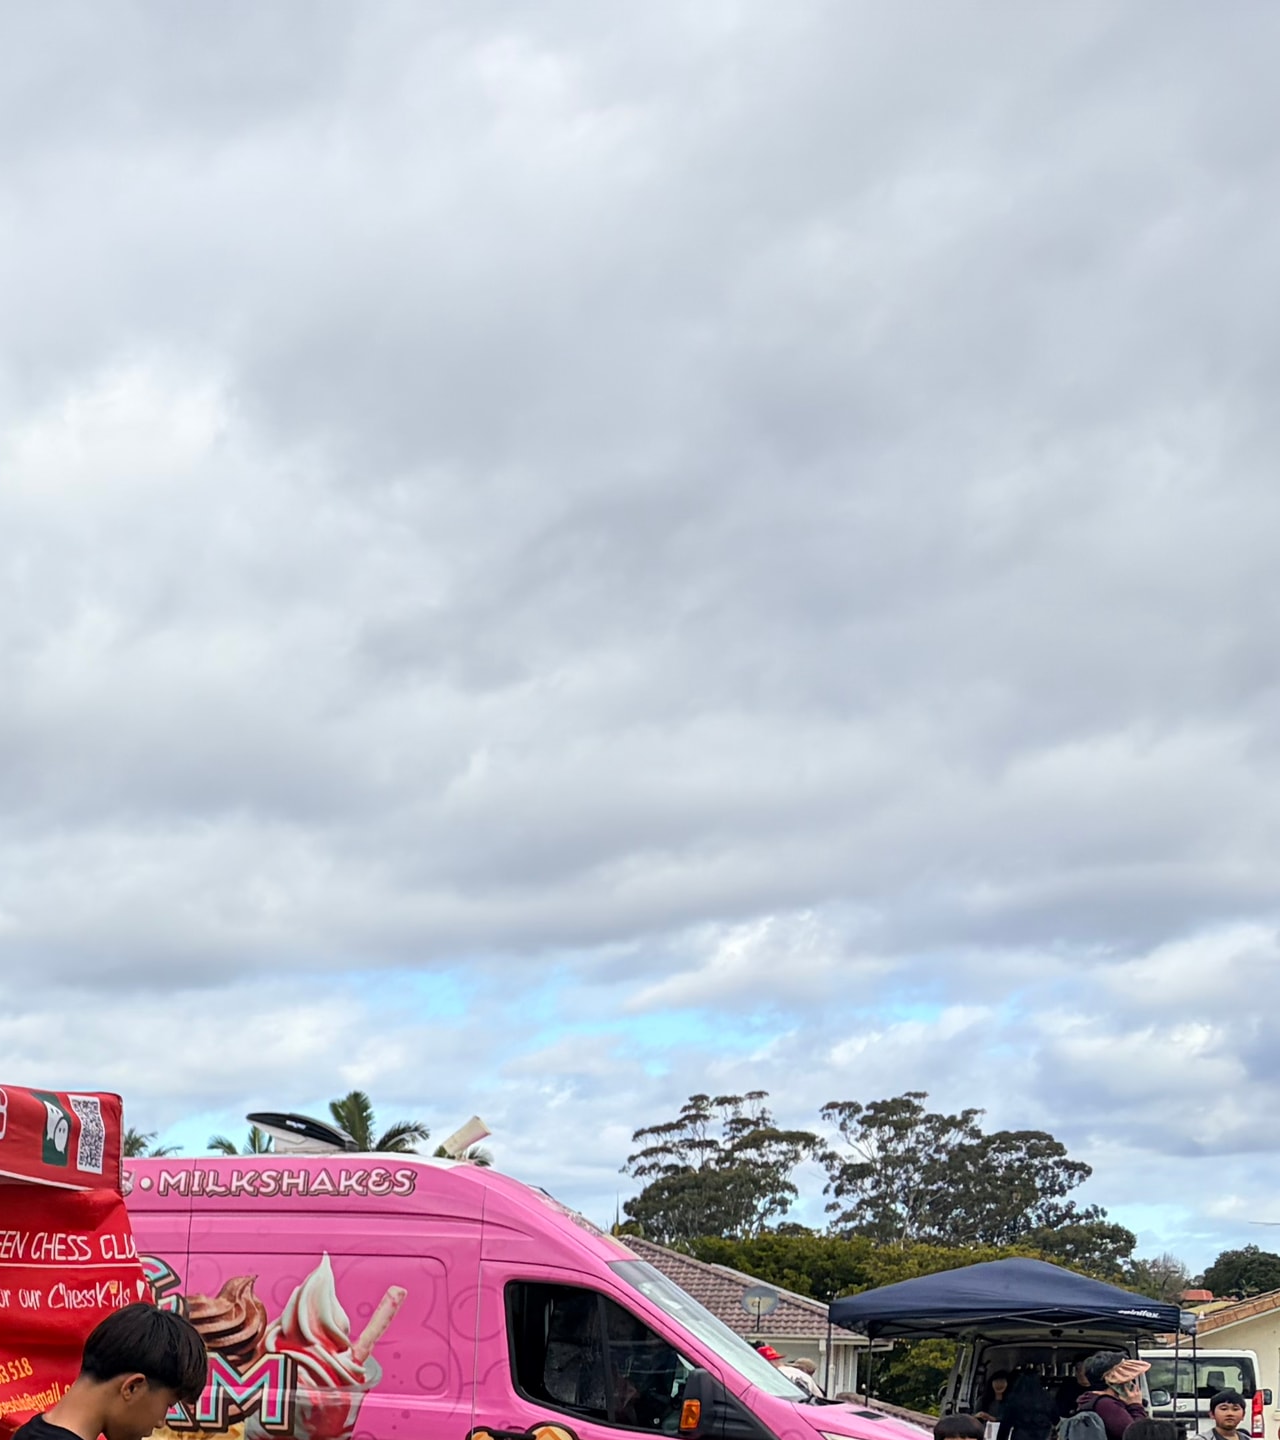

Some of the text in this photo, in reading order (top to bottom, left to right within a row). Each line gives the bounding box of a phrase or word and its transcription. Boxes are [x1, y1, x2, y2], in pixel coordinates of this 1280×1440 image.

[158, 1168, 417, 1198] MILKSHAKES
[31, 1231, 92, 1261] CHESS
[100, 1233, 139, 1259] CLU
[18, 1290, 42, 1309] our
[7, 1357, 34, 1381] 518
